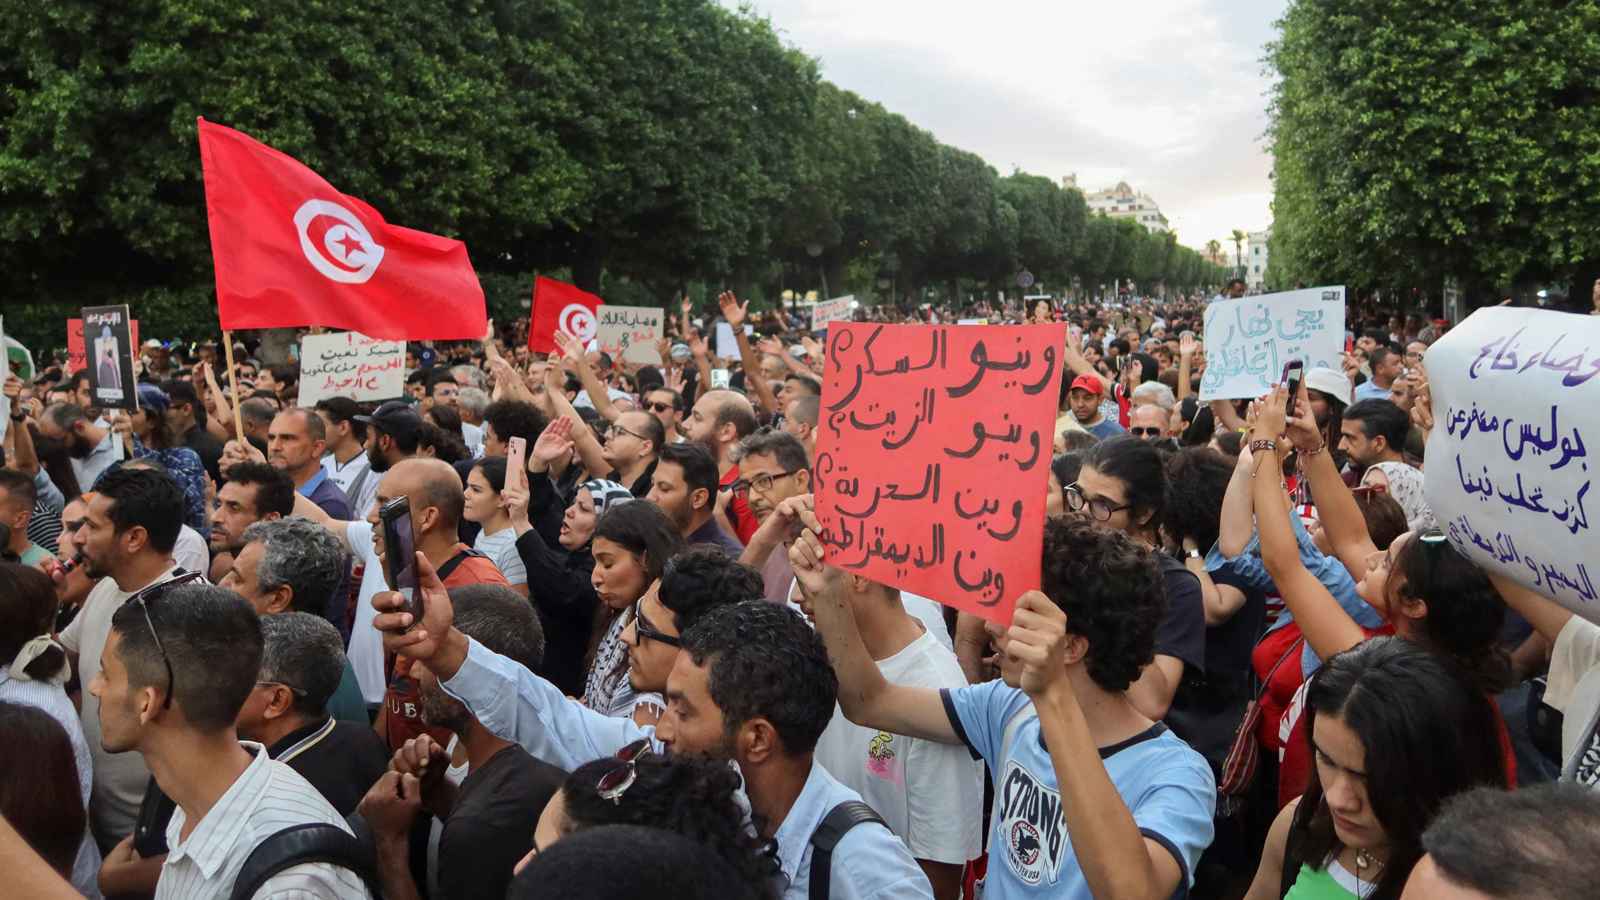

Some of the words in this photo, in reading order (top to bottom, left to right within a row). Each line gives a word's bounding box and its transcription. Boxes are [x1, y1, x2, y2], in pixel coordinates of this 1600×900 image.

[824, 325, 947, 411] السكر؟
[945, 335, 1056, 398] وينو
[943, 413, 1040, 471] وينو
[1503, 405, 1586, 472] بوليس
[954, 487, 1023, 541] وين
[953, 549, 1005, 607] وين
